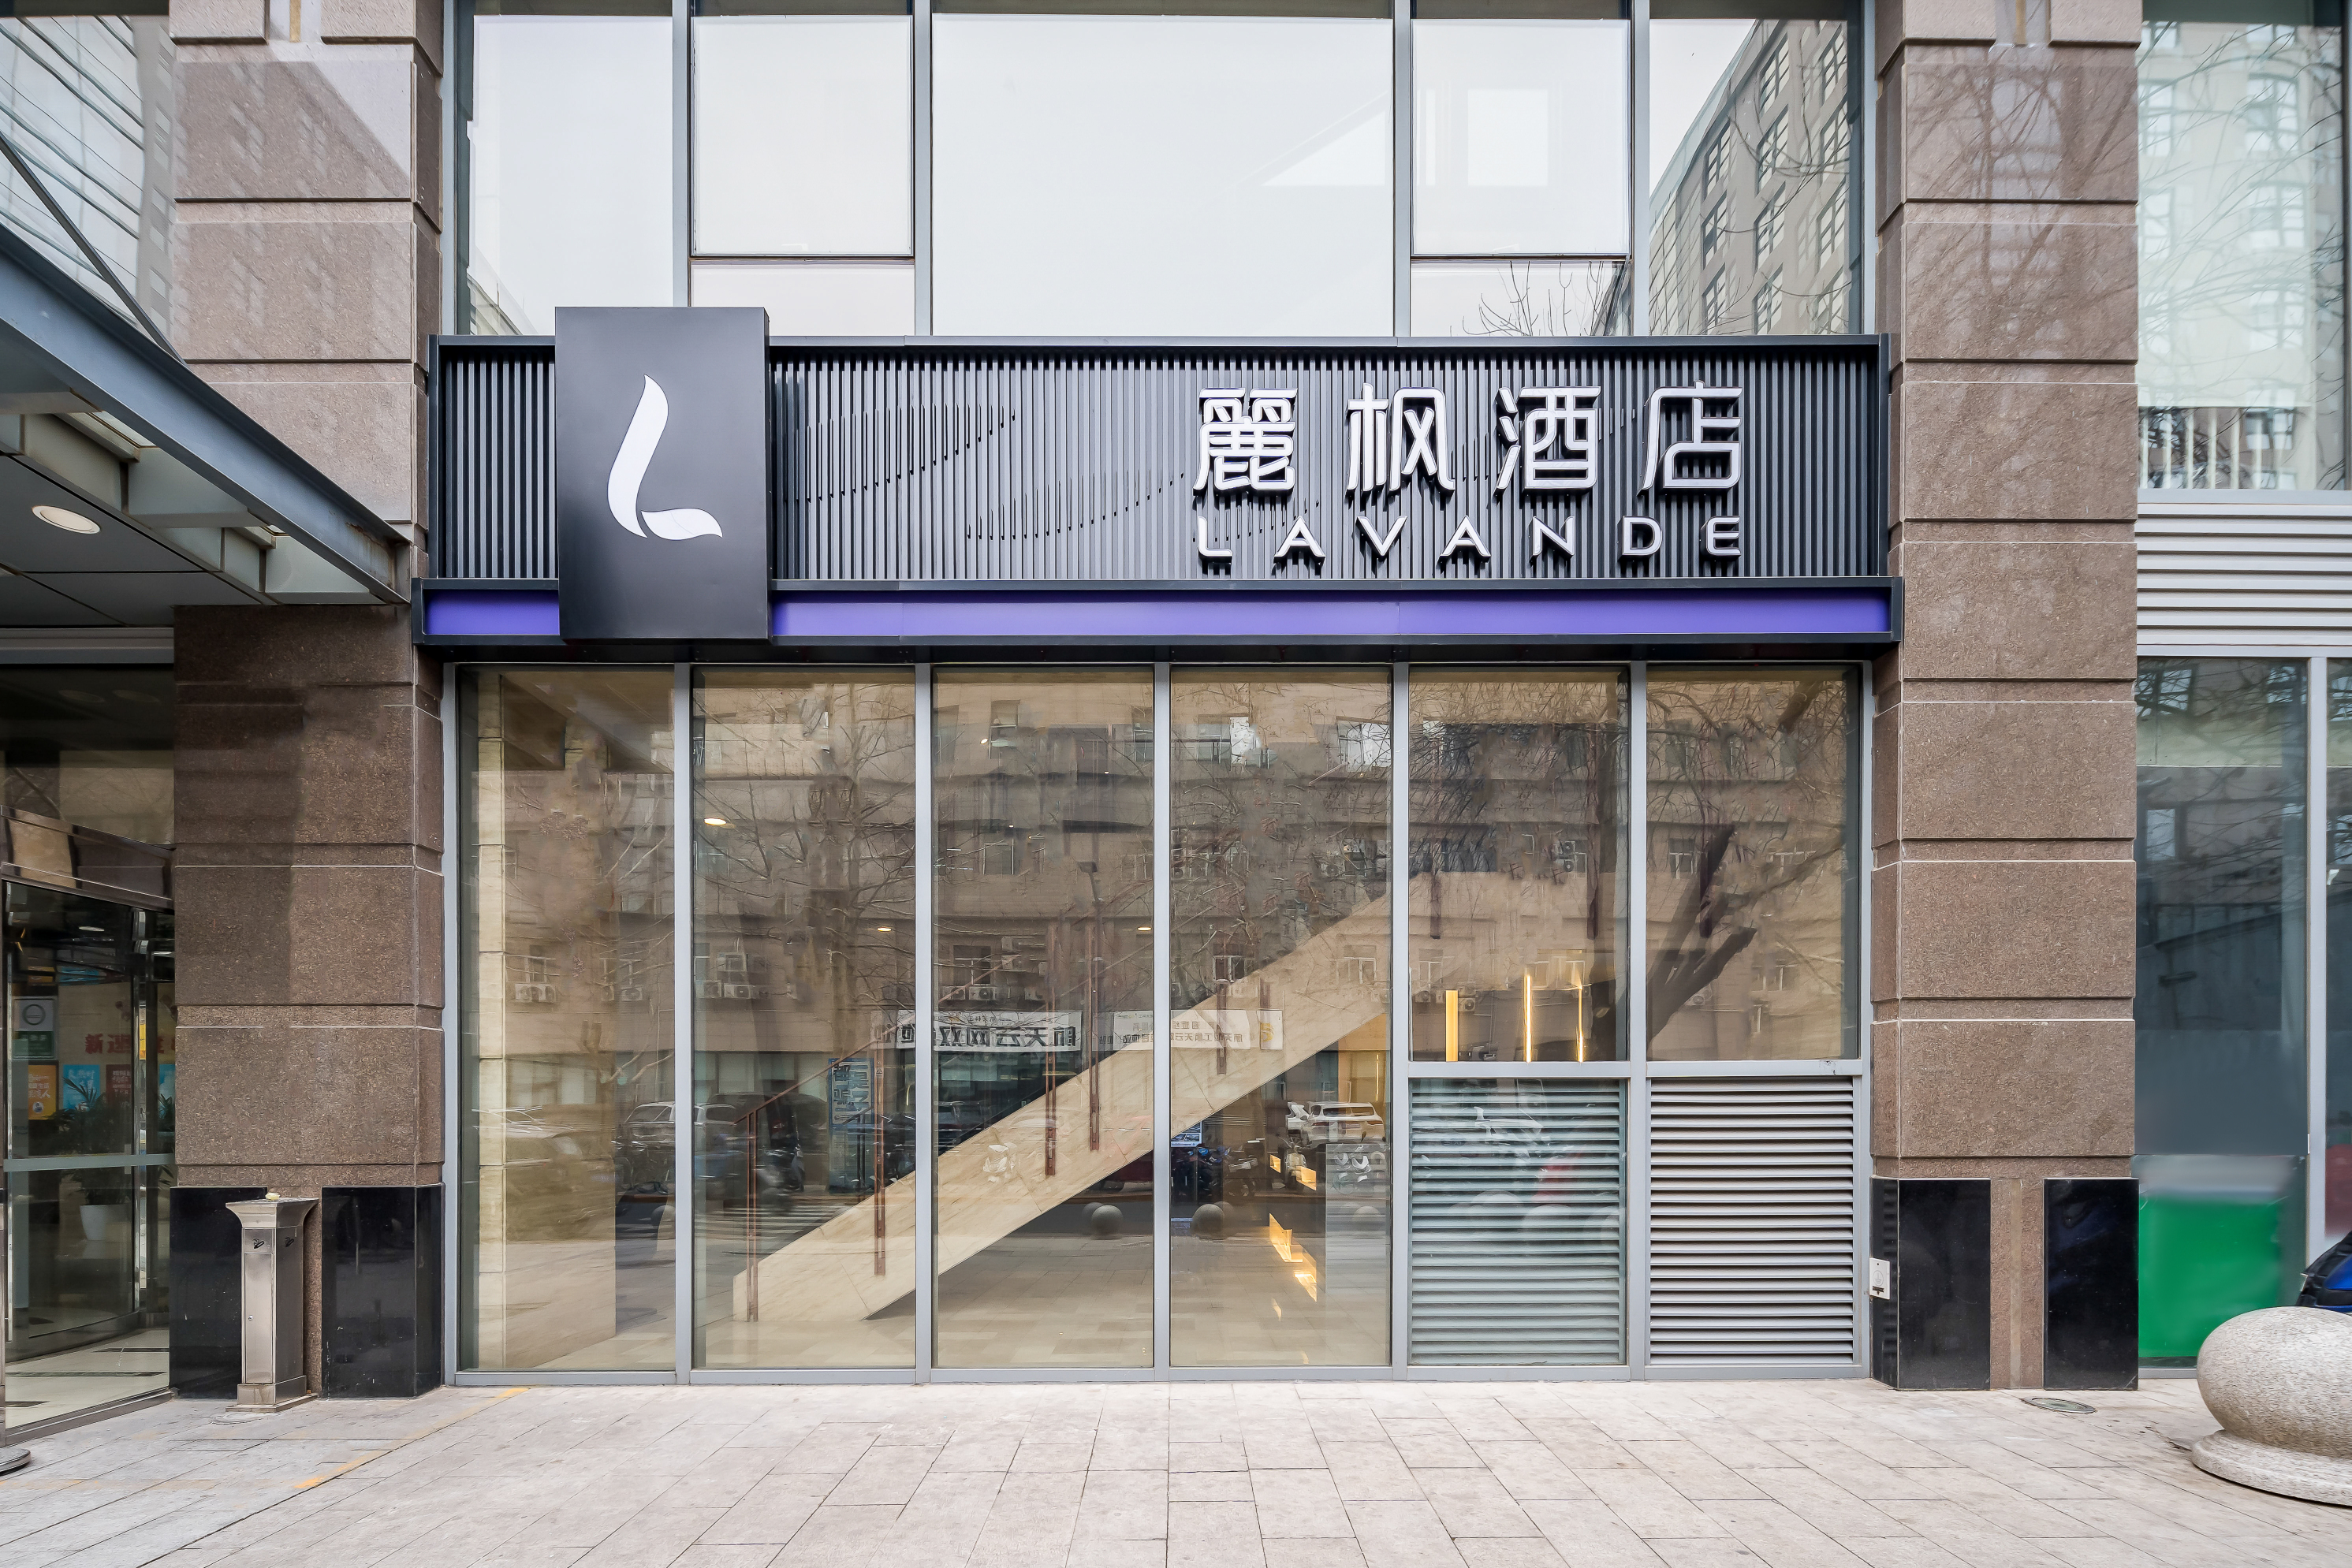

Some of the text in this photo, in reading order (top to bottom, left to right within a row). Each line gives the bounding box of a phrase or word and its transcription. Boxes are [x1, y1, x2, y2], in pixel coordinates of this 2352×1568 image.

[1194, 381, 1743, 495] 麗枫酒店
[1198, 516, 1742, 559] LAVANDE
